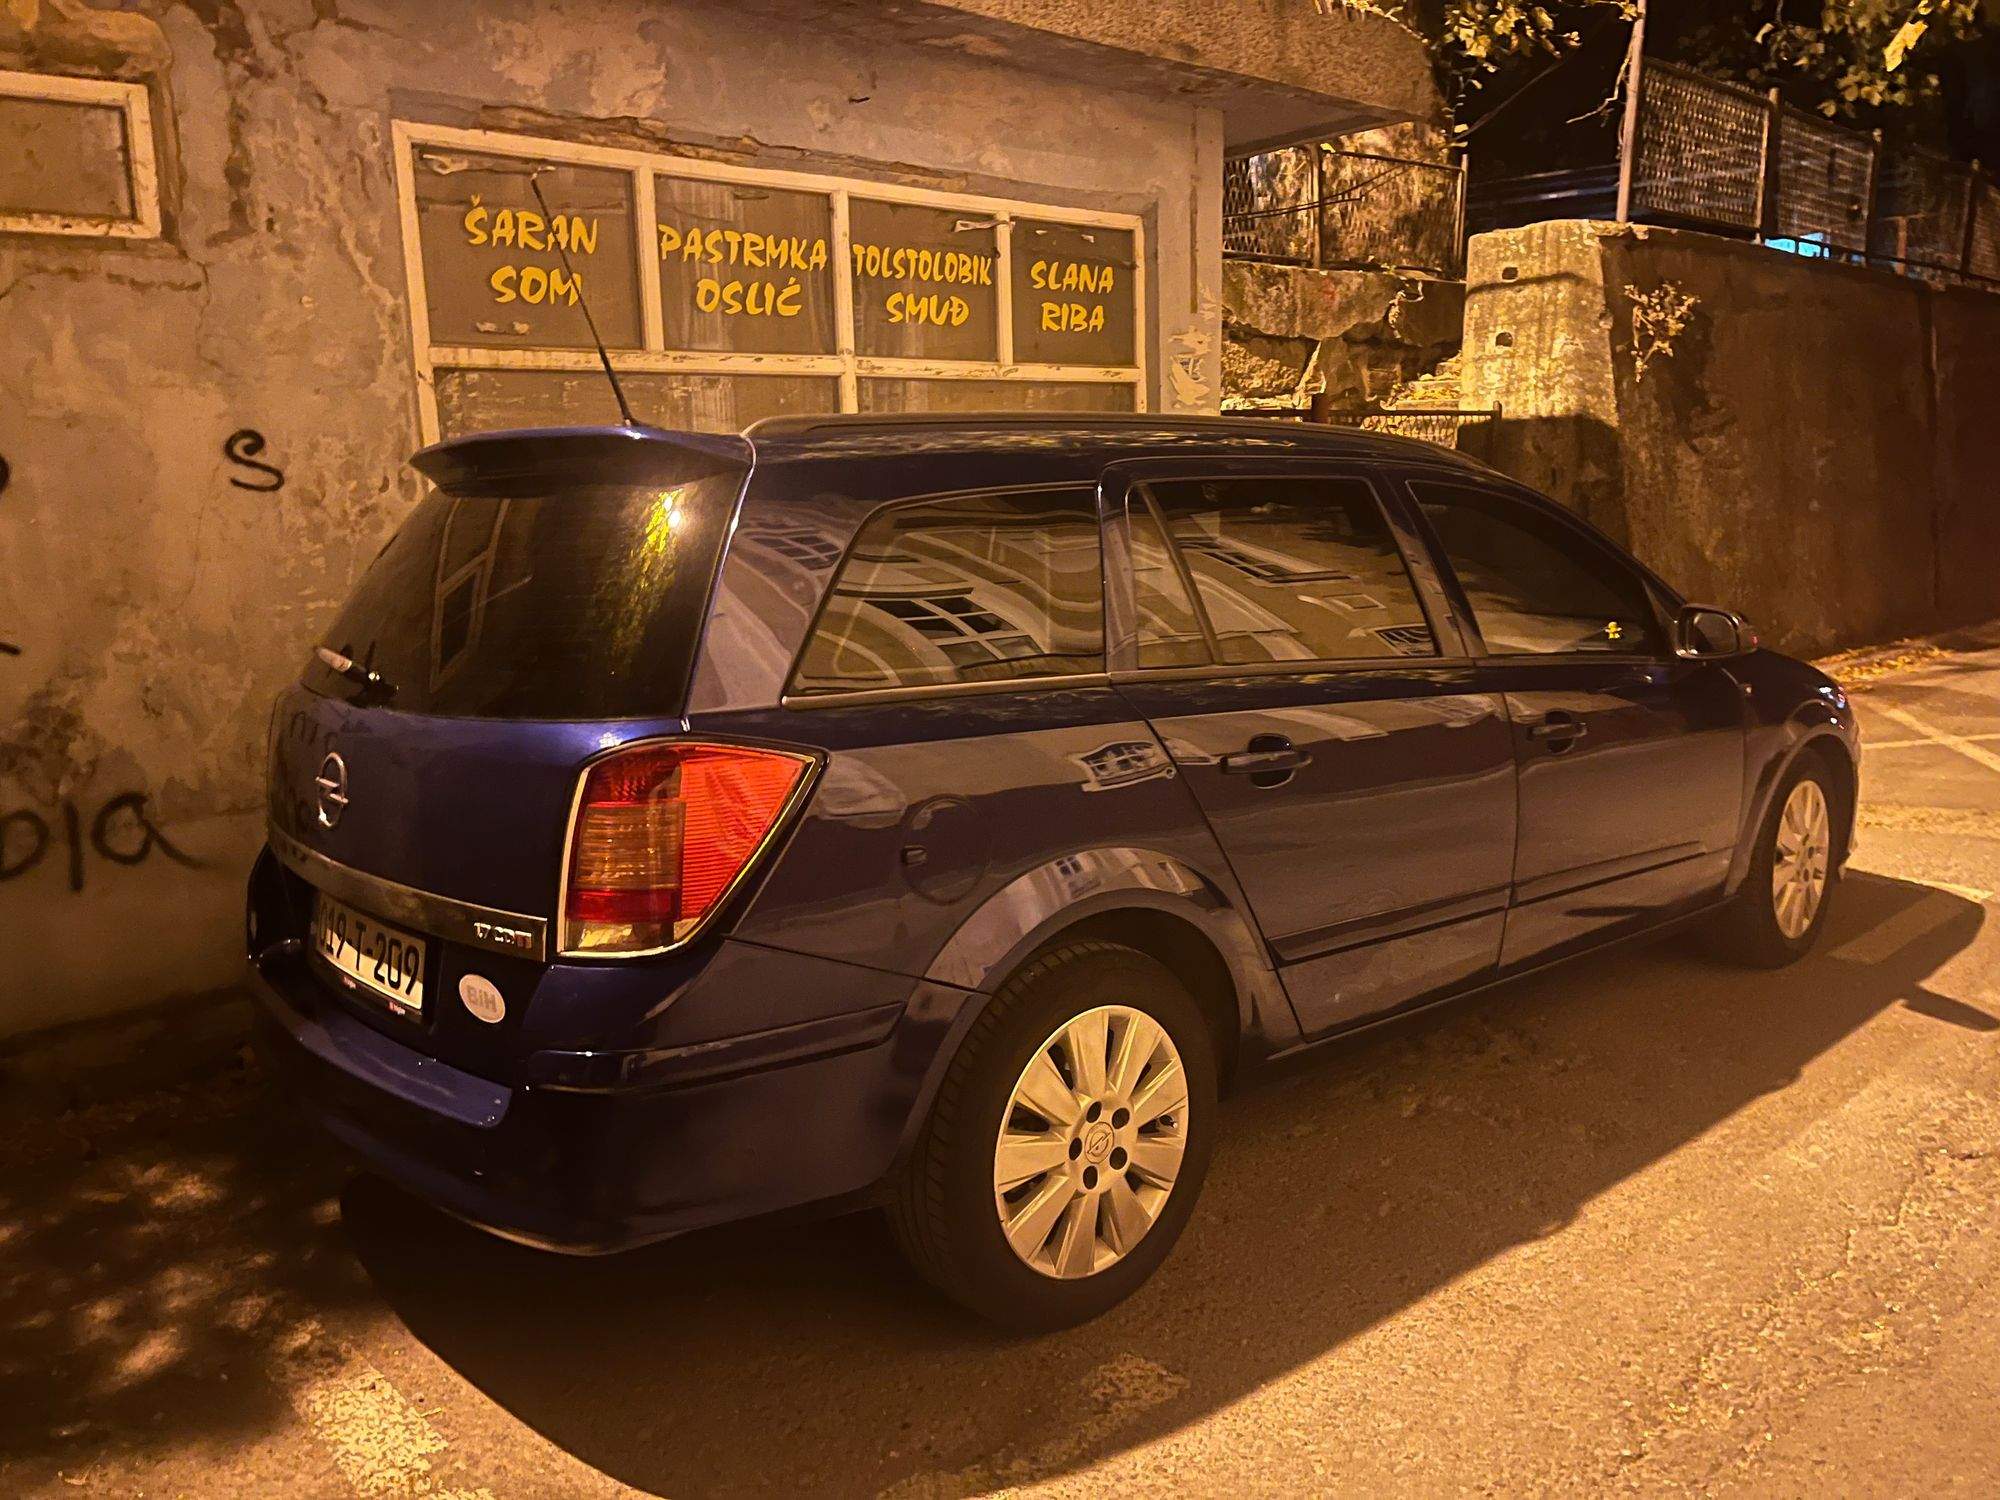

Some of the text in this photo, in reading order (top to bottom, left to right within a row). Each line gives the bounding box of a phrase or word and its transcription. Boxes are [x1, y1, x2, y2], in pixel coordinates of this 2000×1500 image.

[464, 194, 598, 254] ŠARAN
[657, 223, 828, 272] PASTRMKA
[852, 243, 993, 287] TOLSTOLOBIK
[490, 265, 582, 306] SOM
[696, 276, 803, 317] OSLIĆ
[1030, 260, 1115, 295] SLANA
[885, 291, 970, 327] SMUĐ
[1040, 301, 1105, 333] RIBA
[224, 428, 285, 492] S
